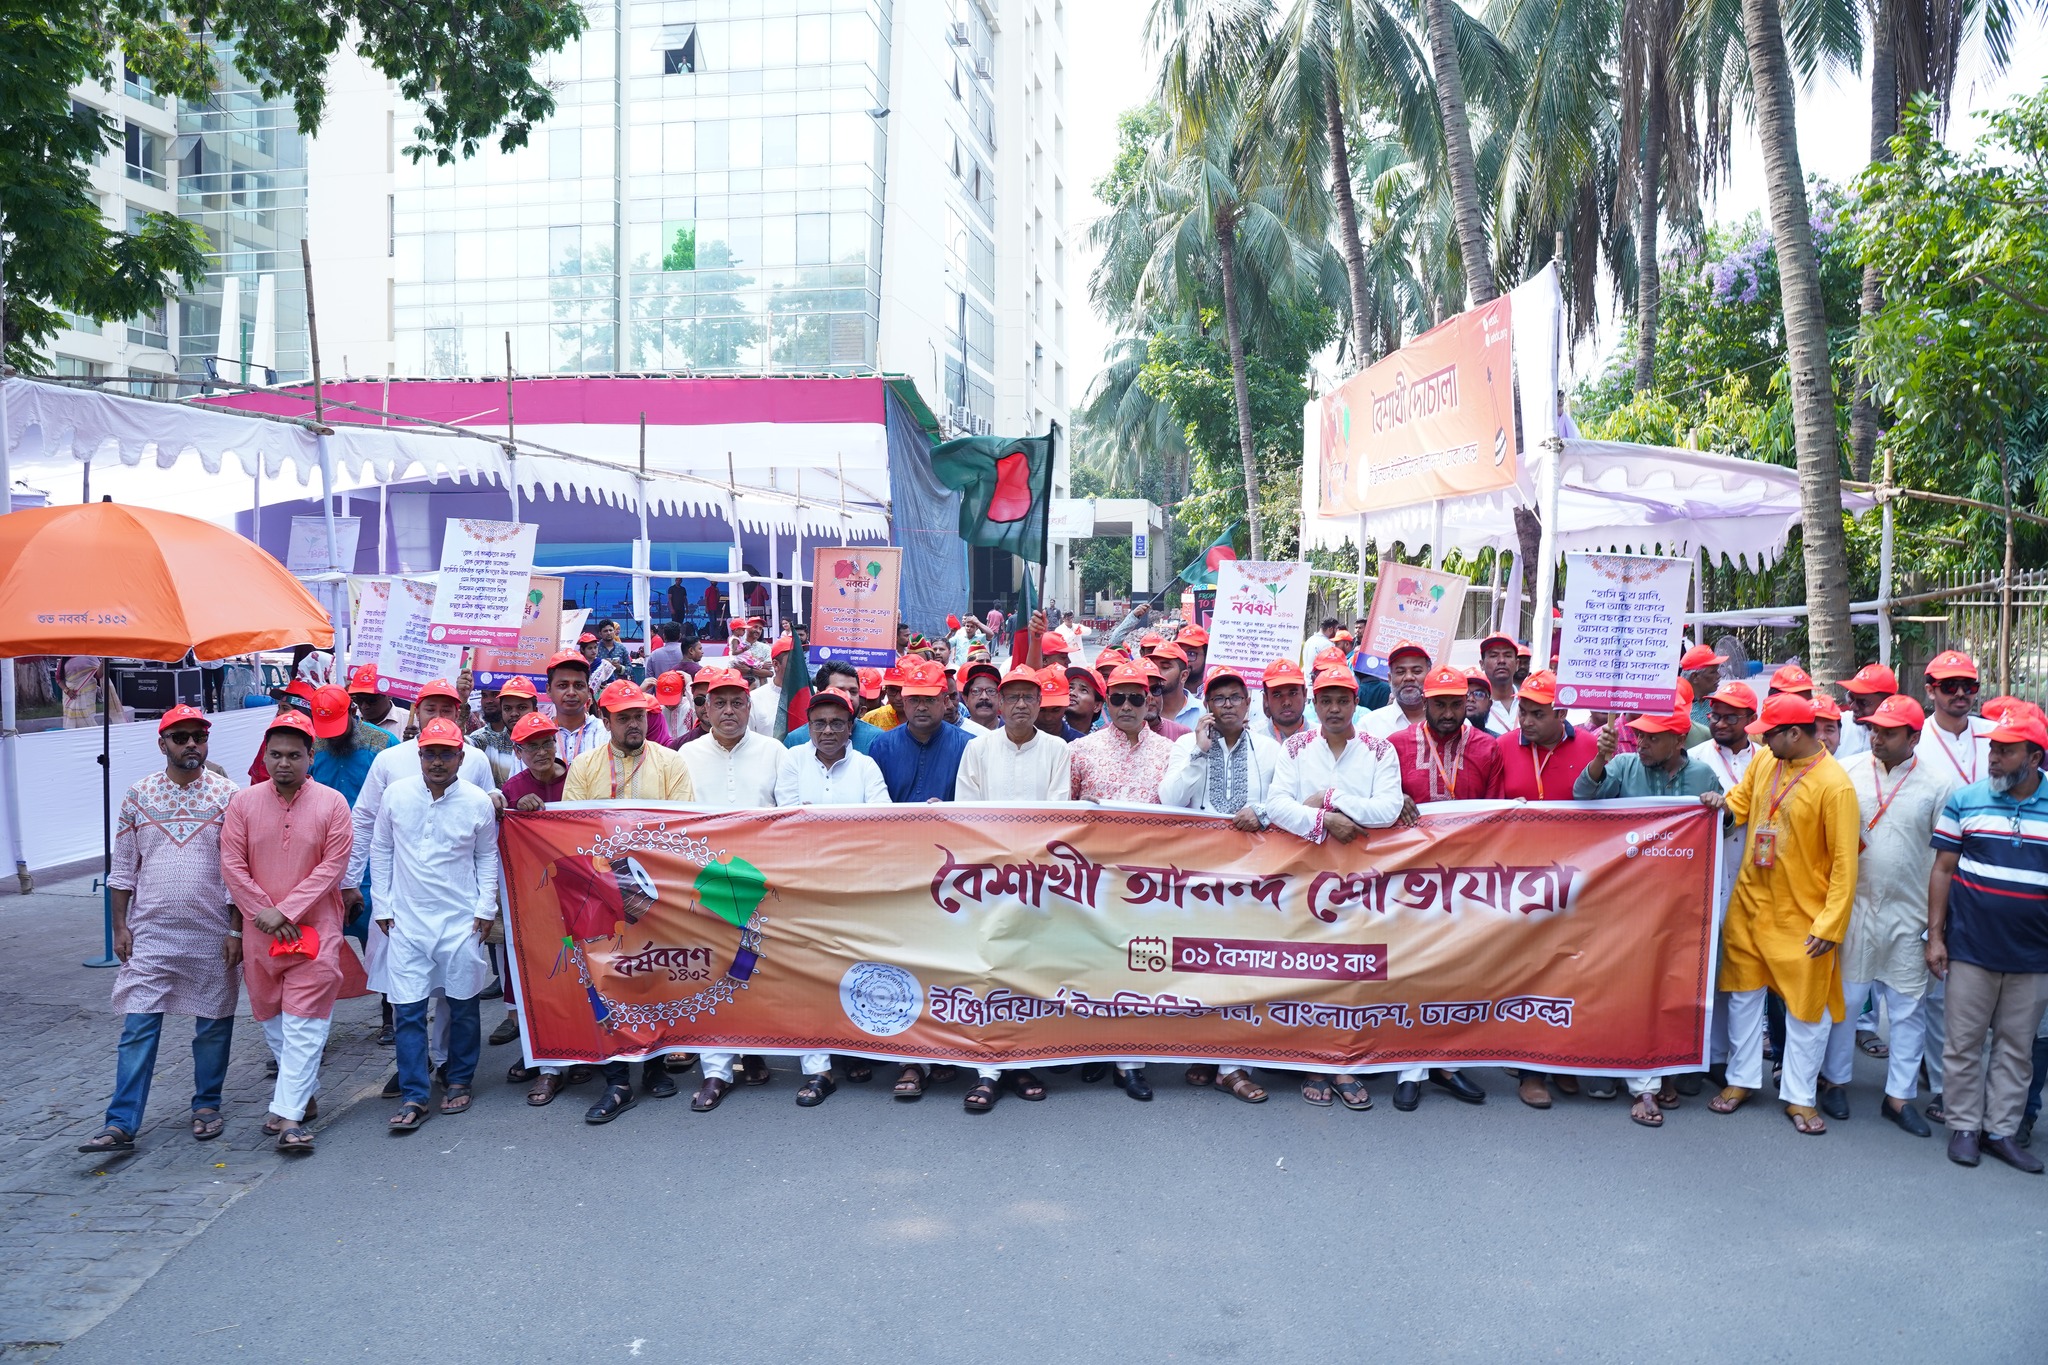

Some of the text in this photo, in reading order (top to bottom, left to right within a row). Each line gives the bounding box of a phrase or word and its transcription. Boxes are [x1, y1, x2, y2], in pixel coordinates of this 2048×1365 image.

[1371, 364, 1458, 434] বৈশাখী দোচালা
[846, 578, 871, 588] নববর্ষ
[1592, 589, 1617, 599] “হাসি
[1585, 600, 1665, 612] ছিল আছে থাকবে
[37, 614, 55, 624] শুভ
[97, 614, 128, 626] ১৪৩২
[1574, 613, 1673, 625] নতুন বছরের শুভ দিন,
[1577, 625, 1668, 635] আসবে কাছে ডাকবে
[1622, 637, 1643, 648] ভুলে
[1583, 648, 1657, 658] নাও মনে ঐ ডাক
[1568, 658, 1597, 667] জানাই
[1599, 660, 1609, 668] হে
[1630, 660, 1670, 670] সকলকে
[1595, 671, 1623, 680] পহেলা
[138, 684, 158, 692] Sandy
[1643, 830, 1674, 842] iebdc
[1642, 846, 1694, 860] iebdc.org
[930, 840, 1582, 923] বৈশাখী আনন্দ শোভাযাত্রা
[612, 941, 714, 977] বর্ষবরণ
[1182, 943, 1377, 973] ০১ বৈশাখ ১৪৩২ বাং
[668, 968, 713, 982] ১৪৩২
[929, 987, 1066, 1027] ইঞ্জিনিয়ার্স
[1267, 1001, 1413, 1031] বাংলাদেশ,
[1419, 1000, 1491, 1026] ঢাকা
[1495, 996, 1575, 1030] কেন্দ্র
